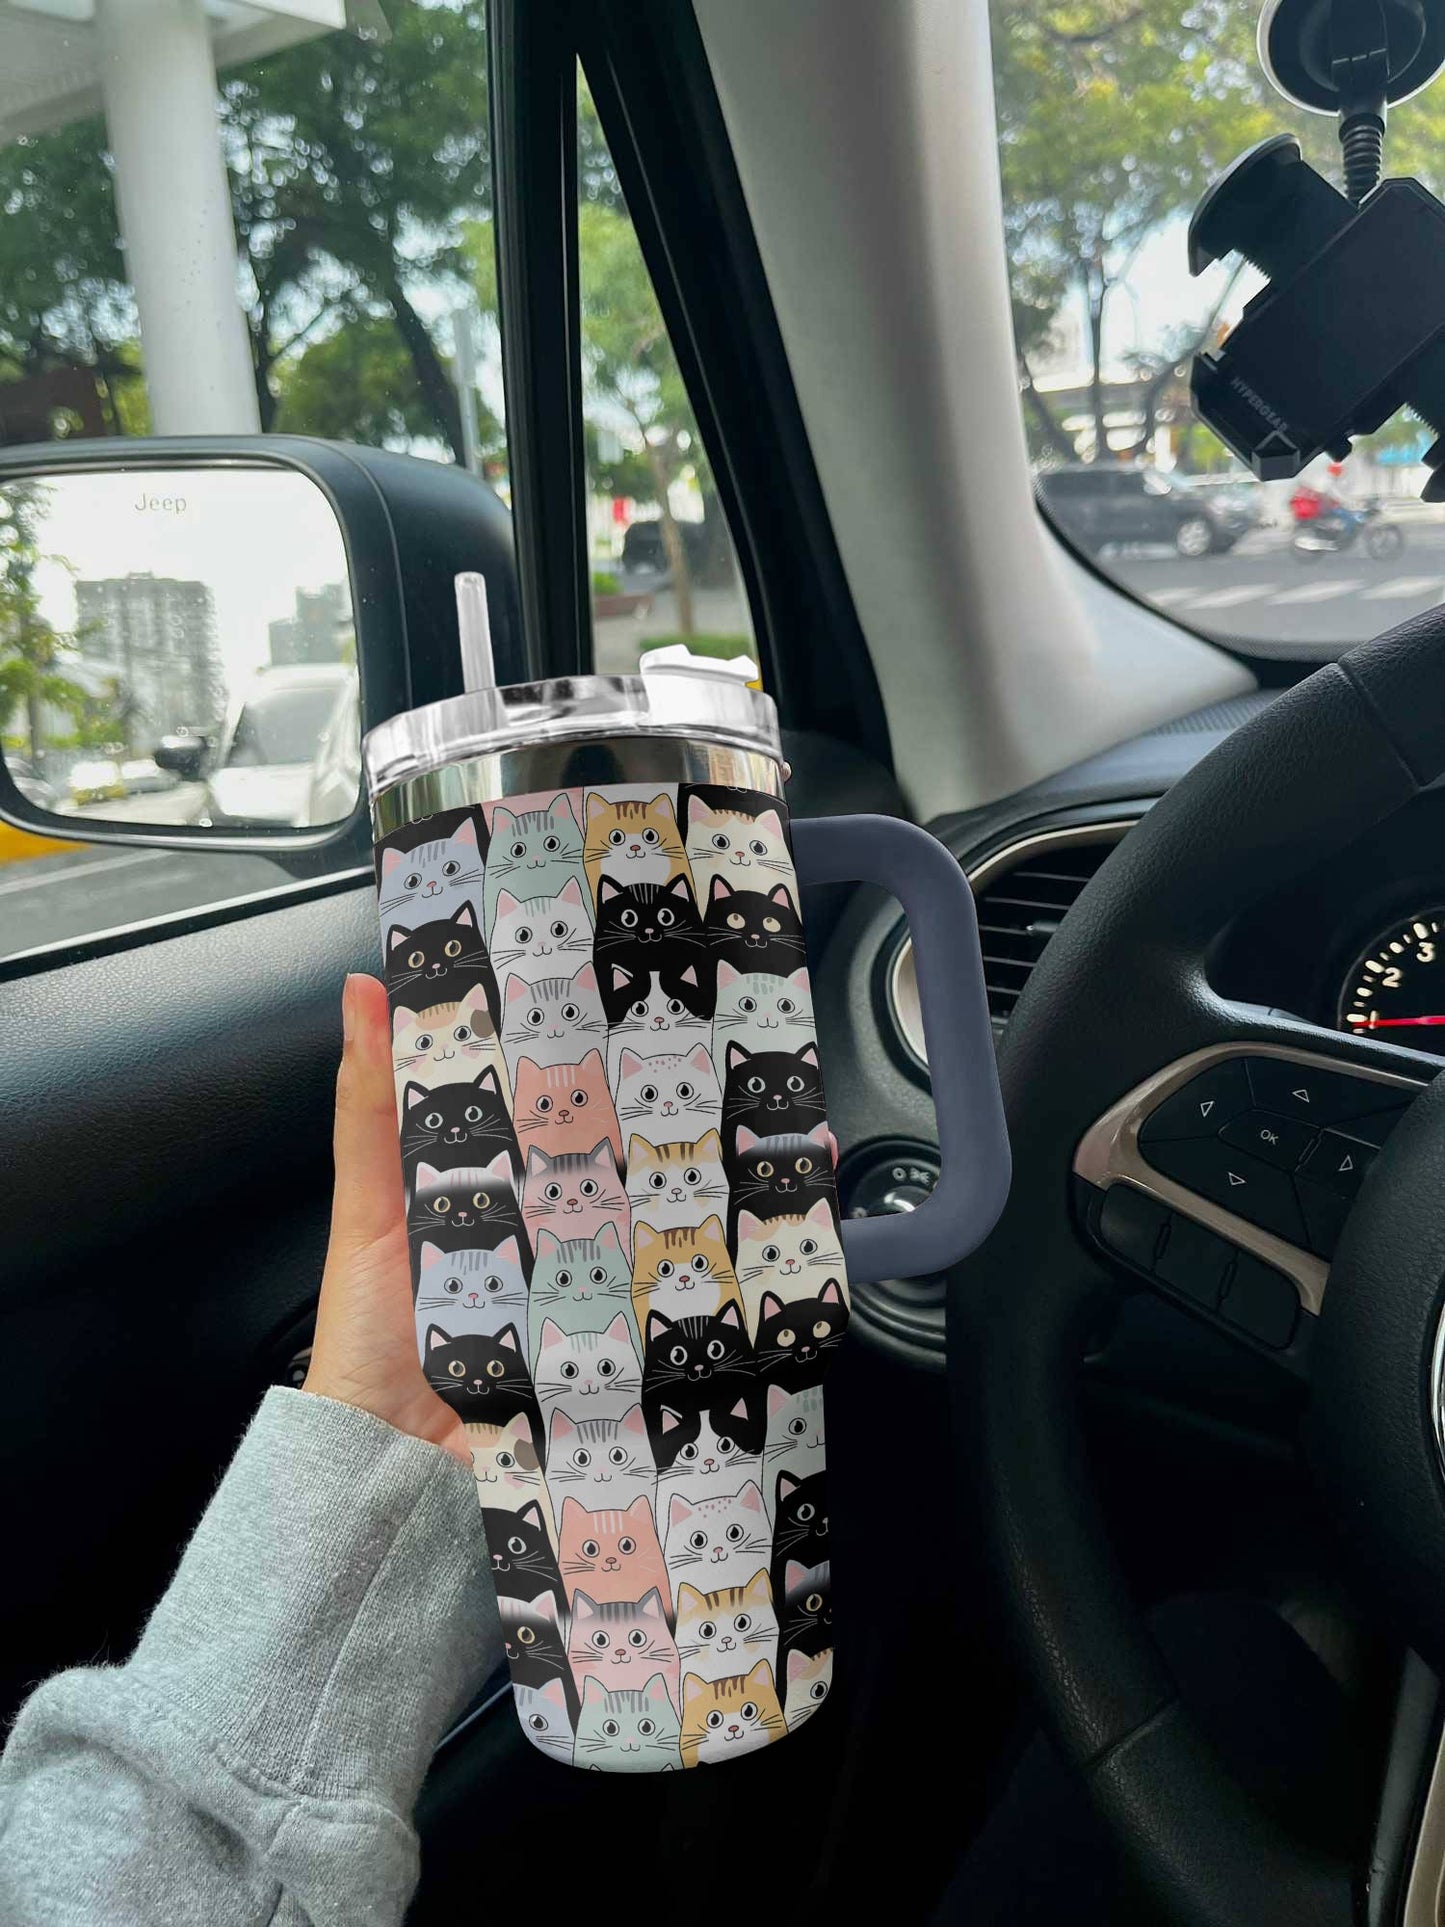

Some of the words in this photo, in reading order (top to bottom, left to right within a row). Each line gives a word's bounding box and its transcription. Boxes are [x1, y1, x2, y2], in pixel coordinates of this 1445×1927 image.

[134, 492, 187, 515] Jeep
[1416, 941, 1435, 962] 3
[1381, 966, 1402, 988] 2
[1260, 1129, 1279, 1146] OK
